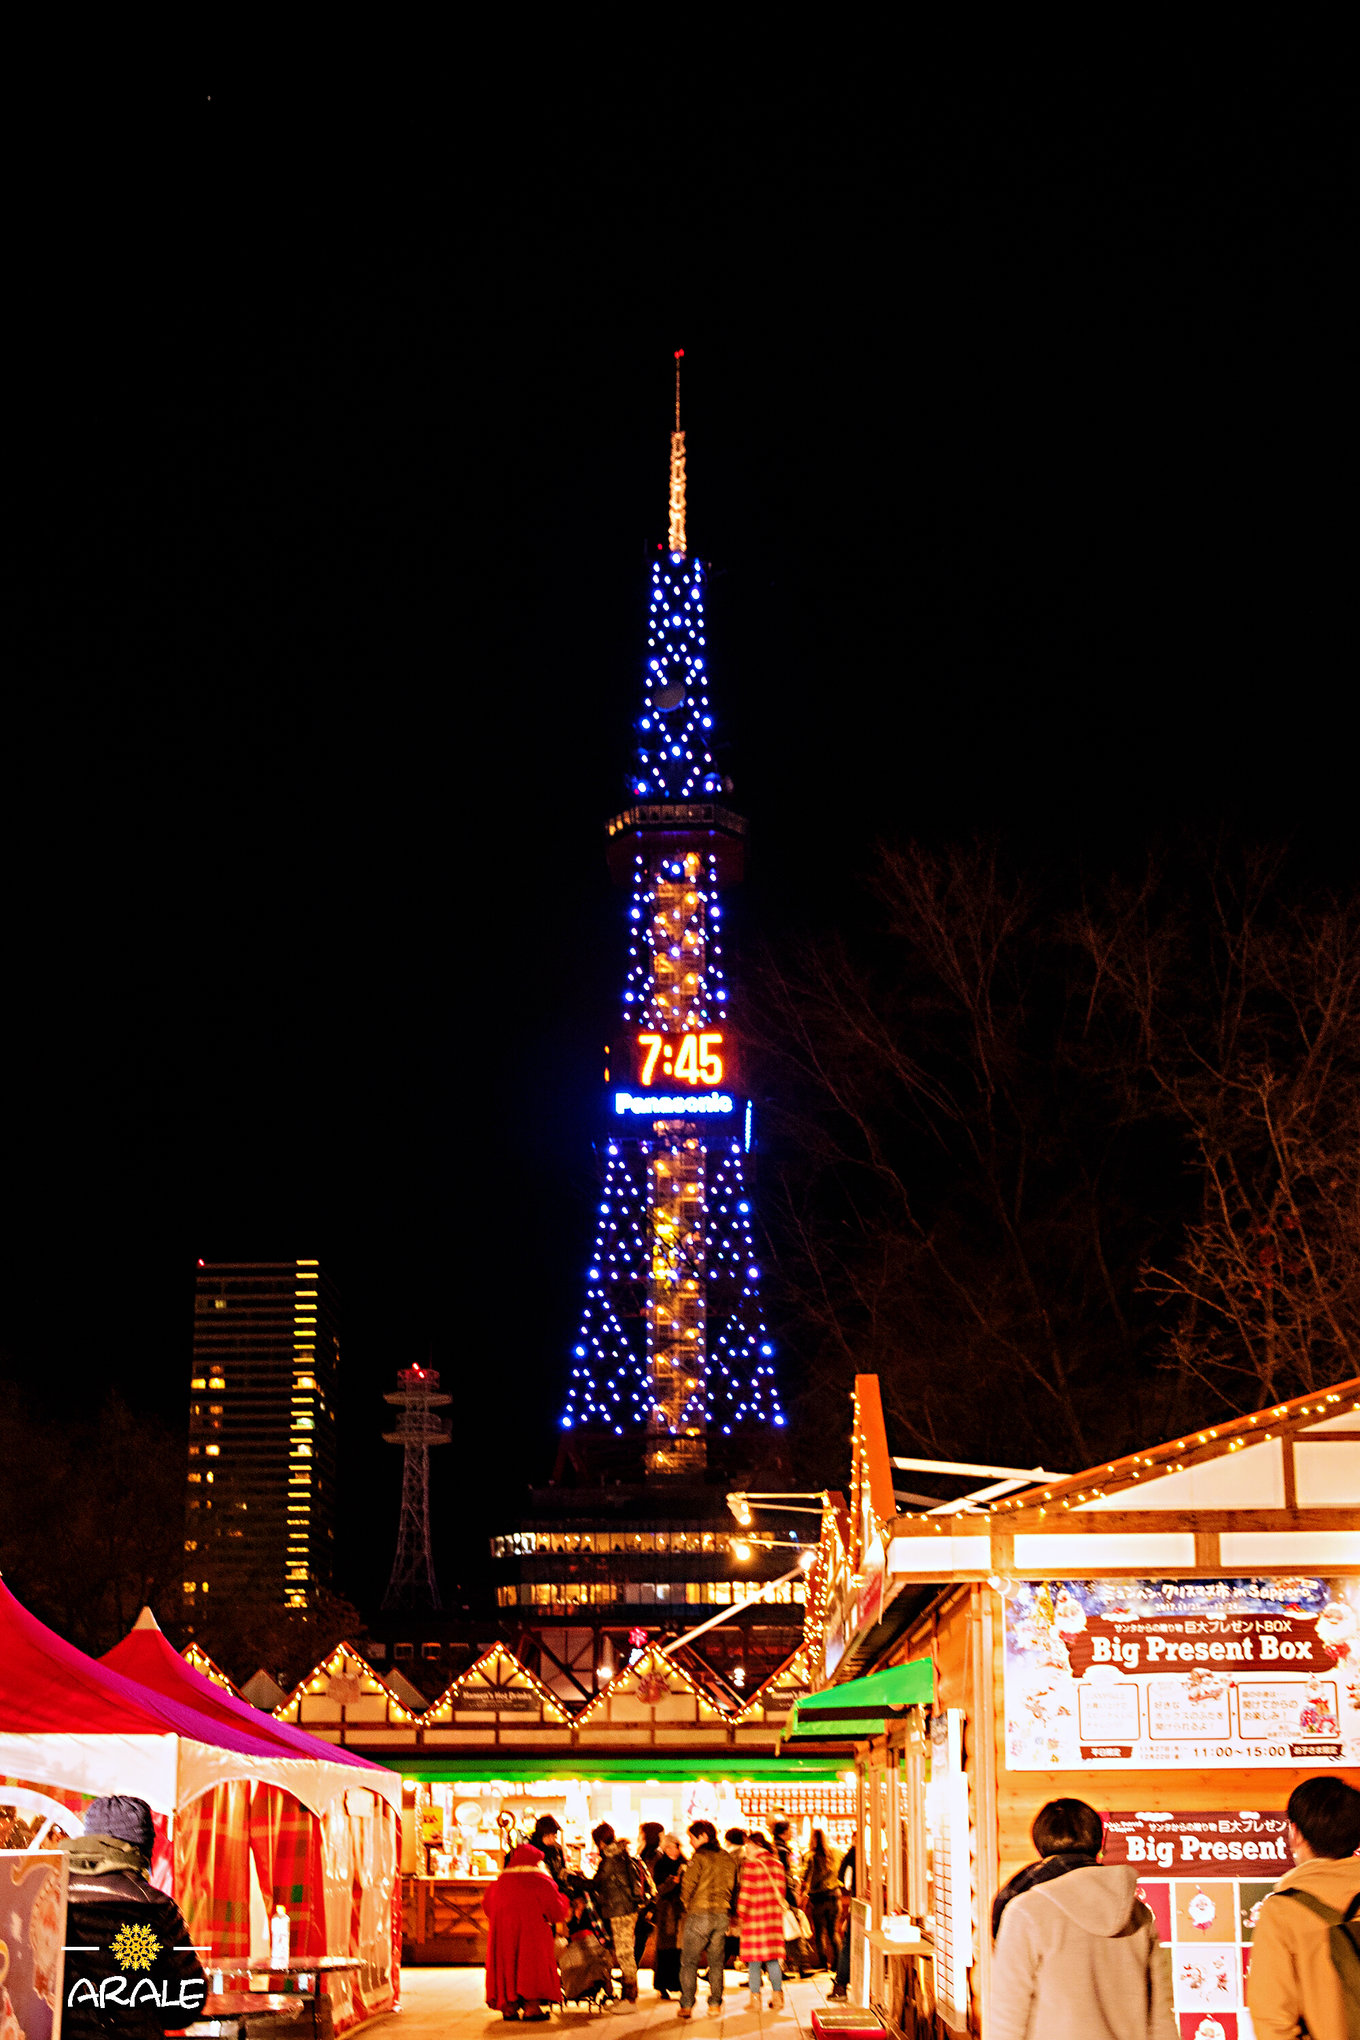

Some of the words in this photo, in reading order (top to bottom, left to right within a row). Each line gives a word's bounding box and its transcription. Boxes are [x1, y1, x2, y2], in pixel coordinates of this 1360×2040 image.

[638, 1033, 723, 1086] 7:45
[615, 1092, 733, 1114] Panasonic
[1249, 1584, 1312, 1602] Sapporo
[1185, 1619, 1293, 1634] 巨大プレゼントBOX
[1091, 1636, 1141, 1668] Big
[1146, 1635, 1254, 1663] Present
[1259, 1635, 1314, 1660] Box
[1125, 1835, 1175, 1868] Big
[1179, 1835, 1287, 1861] Present
